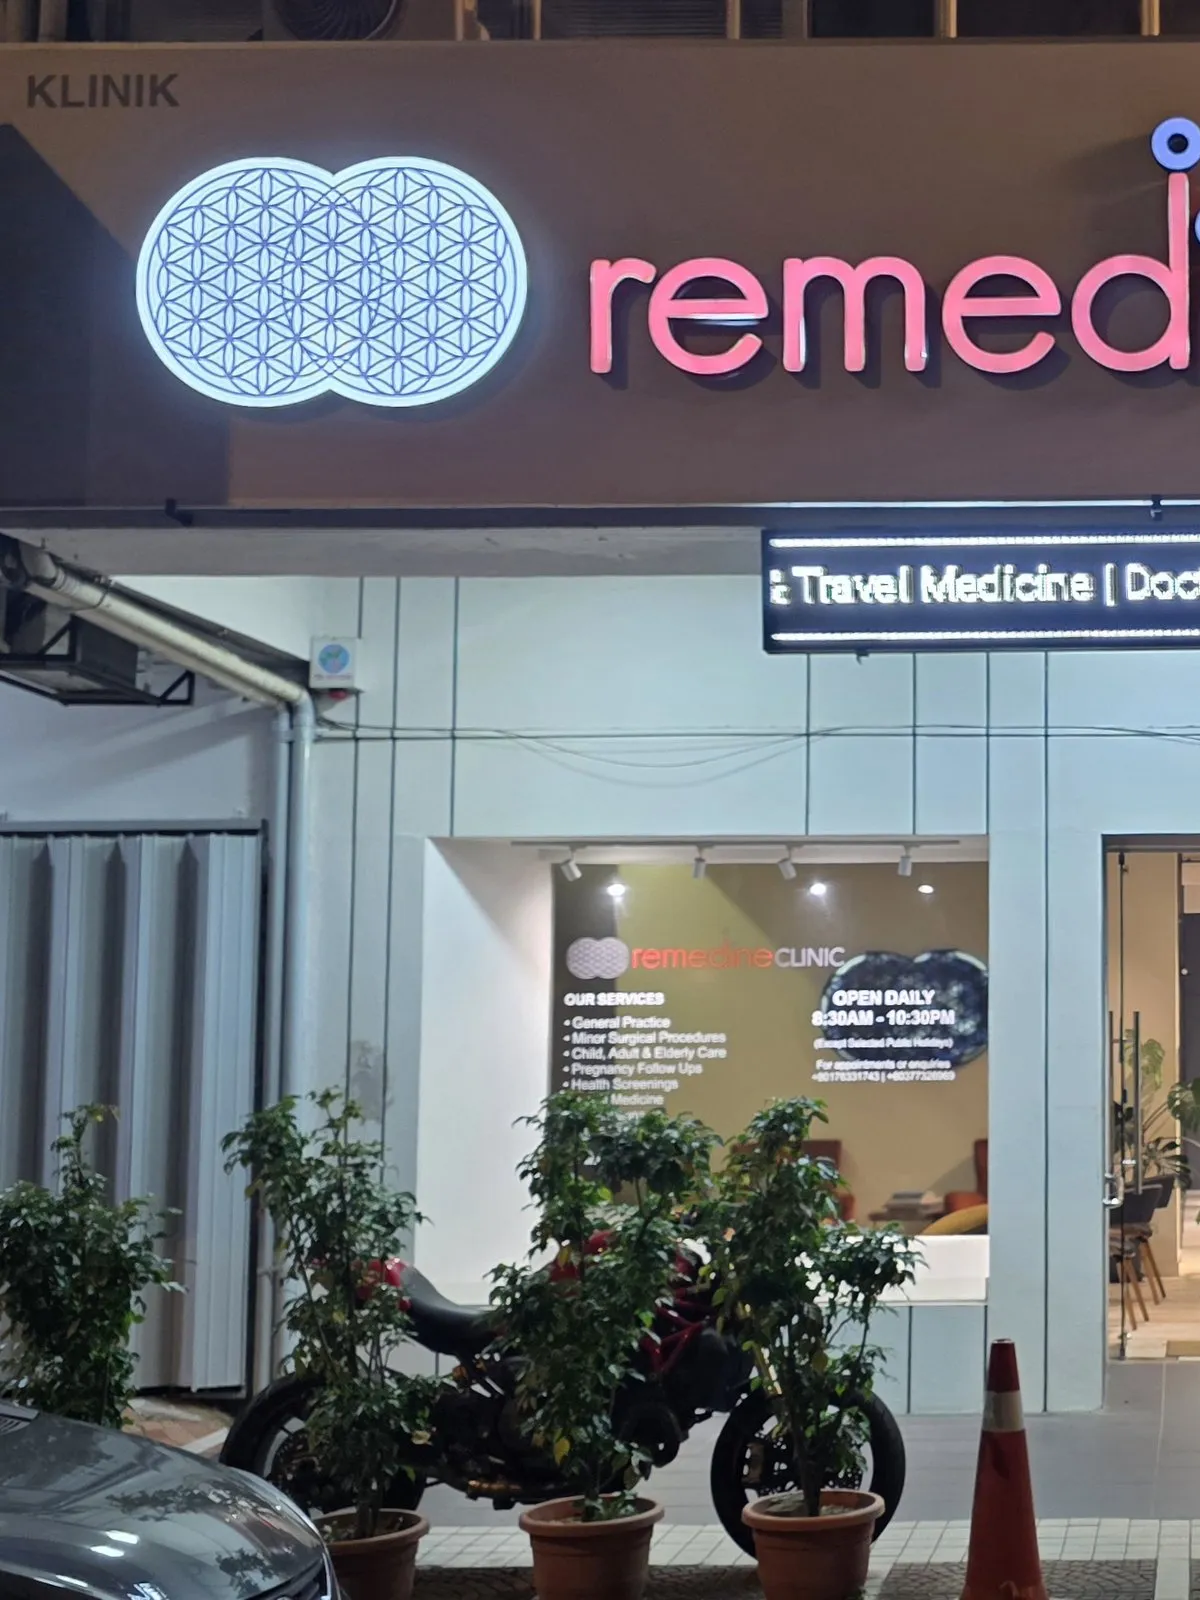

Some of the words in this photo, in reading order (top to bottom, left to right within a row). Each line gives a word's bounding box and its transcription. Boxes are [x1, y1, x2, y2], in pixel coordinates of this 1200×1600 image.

[27, 74, 179, 108] KLINIK
[791, 564, 913, 604] Travel
[921, 563, 1094, 604] Medicine
[631, 938, 774, 969] remedine
[774, 947, 846, 968] CLINIC
[563, 992, 596, 1006] OUR
[597, 992, 665, 1006] SERVICES
[832, 990, 882, 1006] OPEN
[884, 989, 935, 1005] DAILY
[571, 1016, 620, 1029] General
[622, 1015, 671, 1029] Practice
[811, 1010, 874, 1026] 8:30AM
[886, 1009, 955, 1025] 10:30PM
[571, 1032, 606, 1044] Minor
[608, 1031, 656, 1046] Surgical
[659, 1030, 726, 1043] Procedures
[571, 1047, 606, 1060] Child,
[608, 1047, 640, 1059] Adult
[654, 1046, 695, 1061] Elderly
[697, 1046, 727, 1058] Care
[571, 1063, 634, 1077] Pregnancy
[637, 1062, 676, 1074] Follow
[678, 1062, 703, 1076] Ups
[570, 1078, 610, 1090] Health
[612, 1077, 679, 1092] Screenings
[610, 1093, 664, 1105] Medicine
